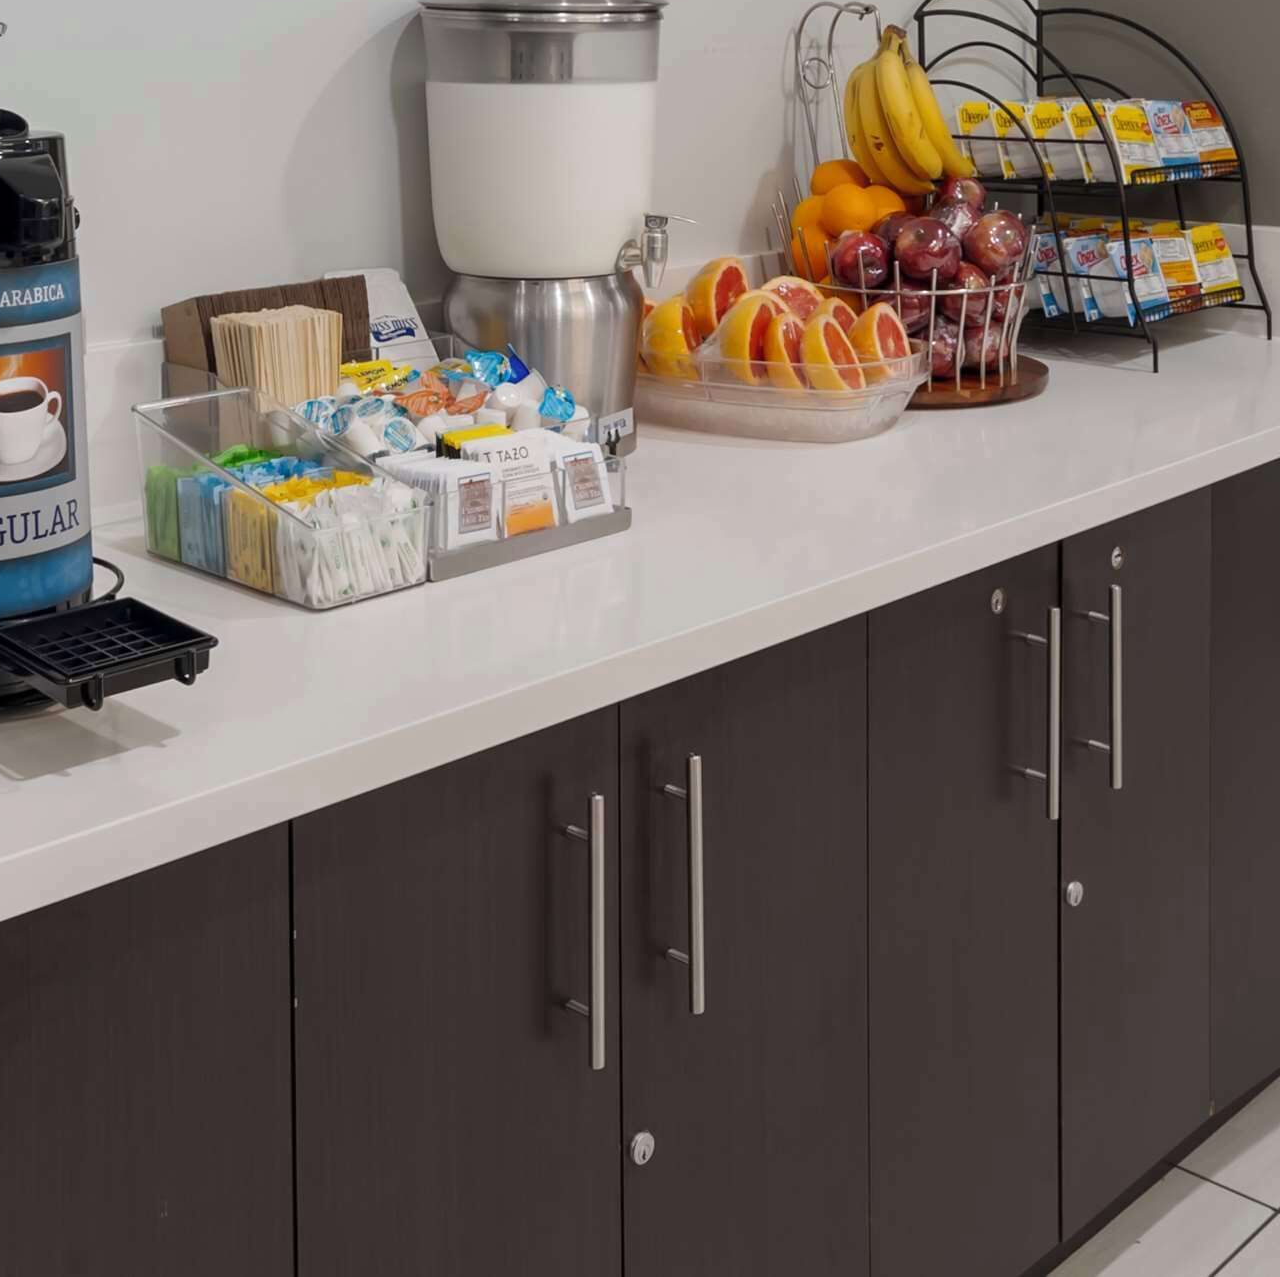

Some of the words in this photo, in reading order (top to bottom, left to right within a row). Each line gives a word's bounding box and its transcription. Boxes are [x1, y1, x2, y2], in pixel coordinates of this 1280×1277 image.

[0, 283, 65, 308] ARABICA
[385, 377, 409, 391] EMON
[496, 446, 529, 463] TAZO
